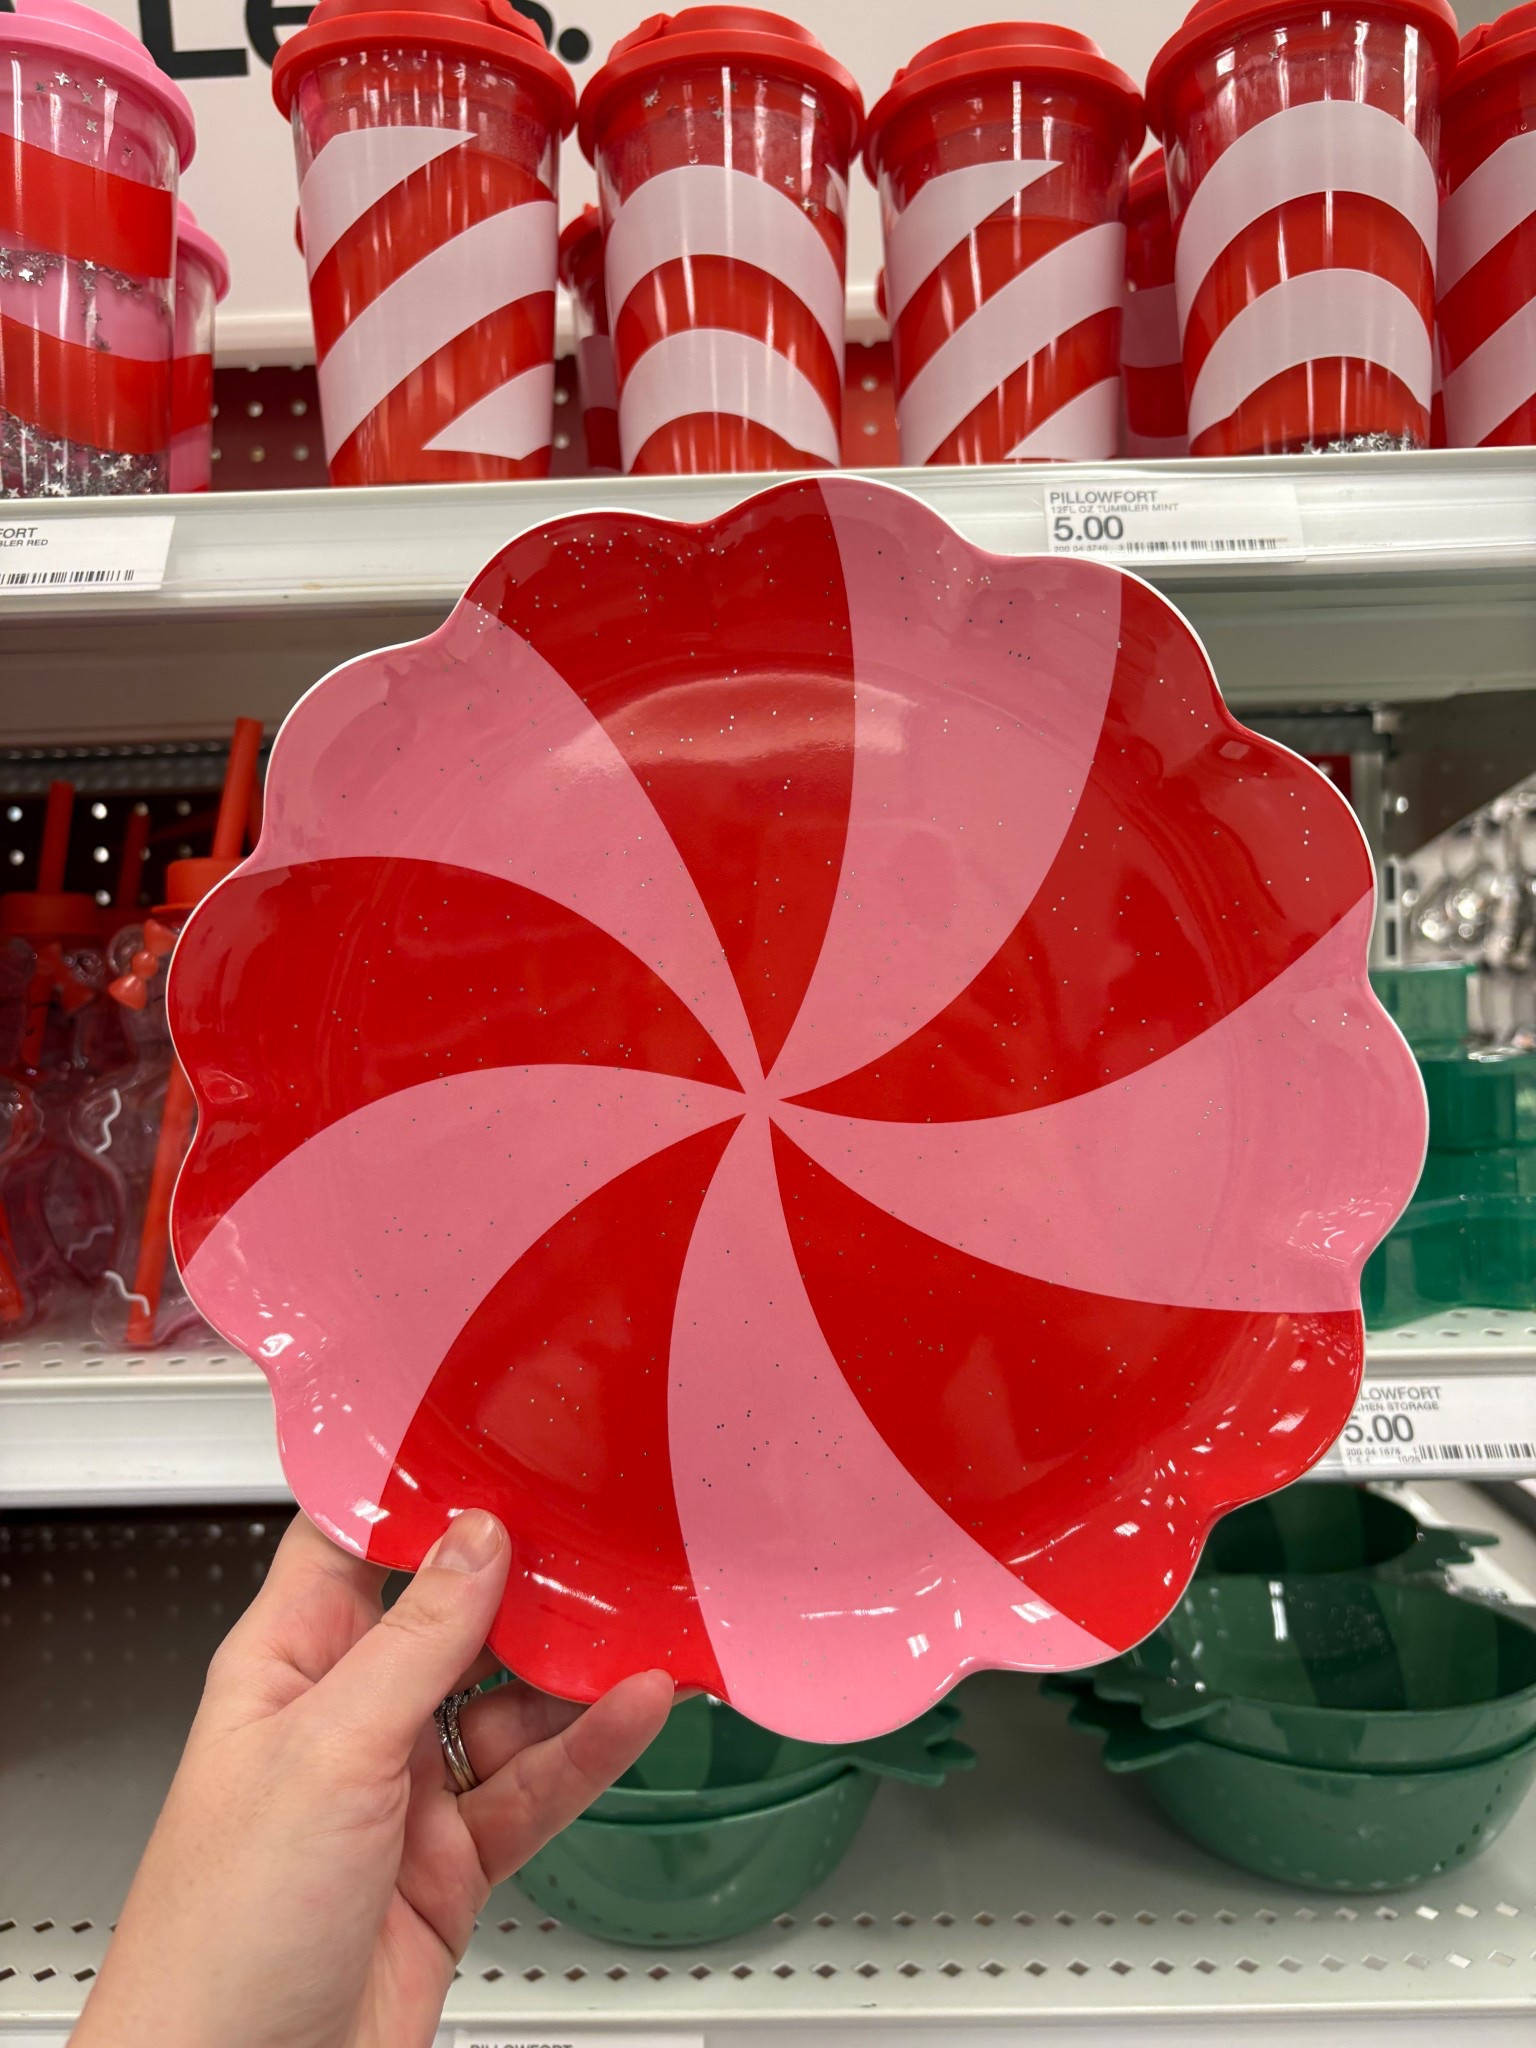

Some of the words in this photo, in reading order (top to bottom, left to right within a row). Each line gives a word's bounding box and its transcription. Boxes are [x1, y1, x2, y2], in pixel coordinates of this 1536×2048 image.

[1050, 491, 1157, 504] PILLOWFORT
[1051, 505, 1076, 513] 12FL
[1079, 505, 1094, 513] OZ
[1097, 504, 1148, 513] TUMBLER
[1152, 503, 1179, 512] MINT
[1053, 515, 1124, 542] 5.00
[1356, 1403, 1384, 1411] HEN
[1387, 1401, 1439, 1411] STORAGE
[1345, 1413, 1414, 1443] 5.00
